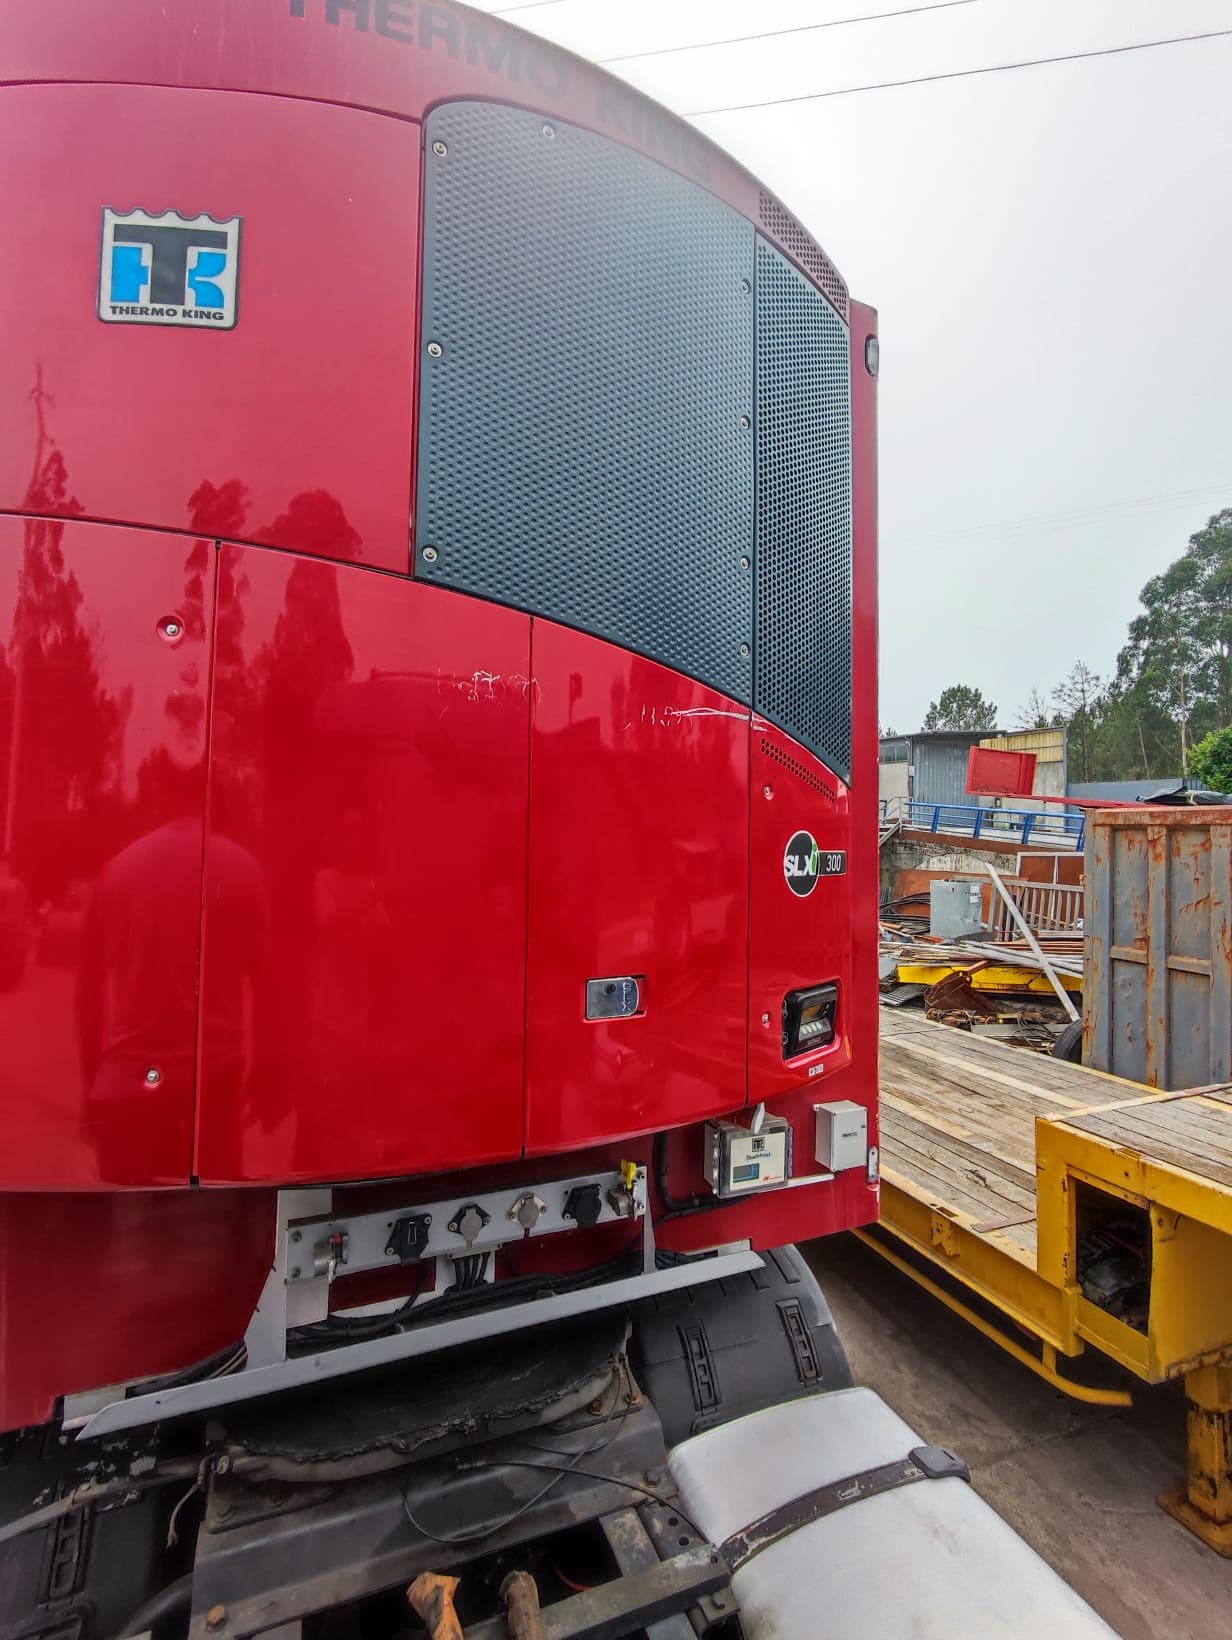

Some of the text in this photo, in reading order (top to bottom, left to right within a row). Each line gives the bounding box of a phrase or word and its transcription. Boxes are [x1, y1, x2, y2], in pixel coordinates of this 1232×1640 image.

[109, 305, 225, 321] THERMO KING
[785, 854, 842, 877] SLX 300
